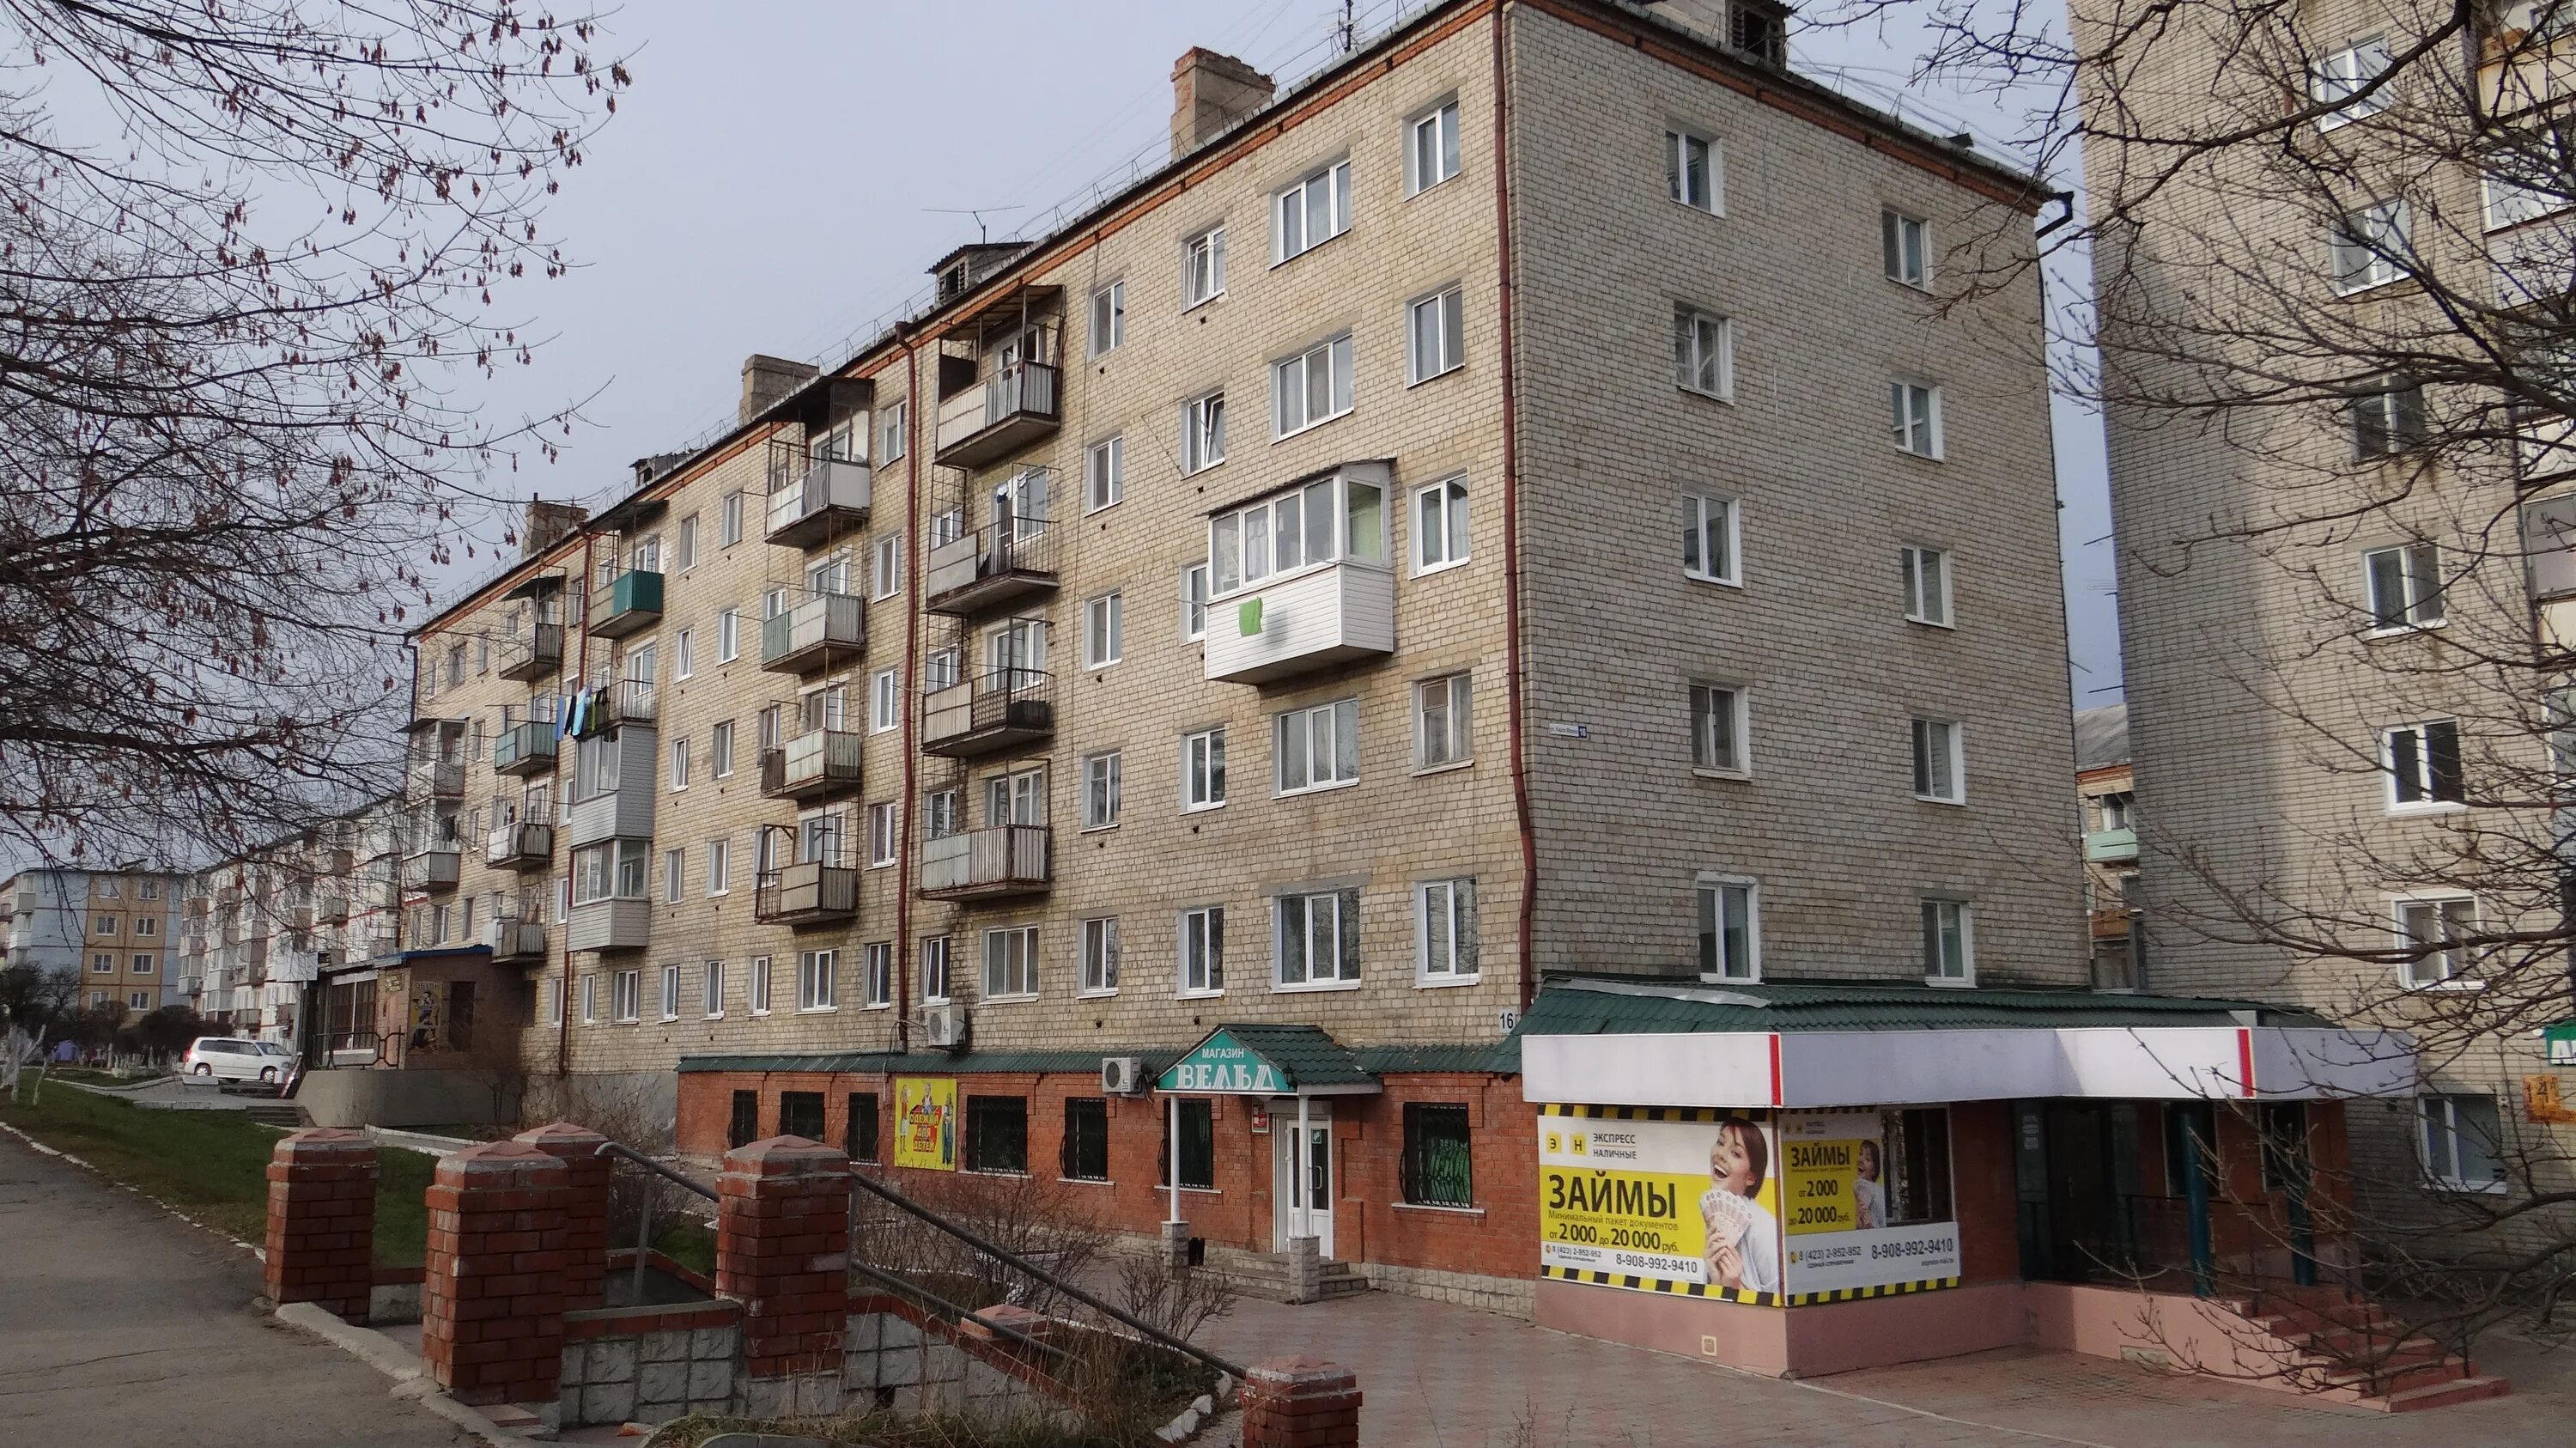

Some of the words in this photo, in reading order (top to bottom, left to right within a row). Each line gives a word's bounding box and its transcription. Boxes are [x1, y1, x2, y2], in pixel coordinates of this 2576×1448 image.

[1500, 1013, 1513, 1029] 16
[1202, 1048, 1244, 1059] МАГАЗИН
[1176, 1064, 1277, 1091] ВЕЛЬД
[910, 1112, 939, 1125] ОДЕЖДА
[913, 1140, 935, 1152] ДЕТЕЙ
[1549, 1138, 1557, 1149] Э
[1574, 1140, 1583, 1151] Н
[1593, 1133, 1636, 1144] ЭКСПРЕСС
[1593, 1149, 1637, 1159] НАЛИЧНЫЕ
[1791, 1142, 1850, 1168] ЗАЙМЫ
[1548, 1171, 1676, 1220] ЗАЙМЫ
[1548, 1210, 1603, 1225] Минимальный
[1605, 1217, 1627, 1226] пакет
[1629, 1219, 1678, 1231] документов
[1549, 1231, 1558, 1239] от
[1599, 1236, 1609, 1246] до
[1662, 1242, 1680, 1254] руб.
[1557, 1246, 1572, 1255] (423)
[1871, 1238, 1953, 1260] 8-908-992-9410
[1805, 1249, 1825, 1262] (423)
[1826, 1246, 1862, 1259] 2-952-952
[1616, 1254, 1698, 1274] 8-908-992-9410
